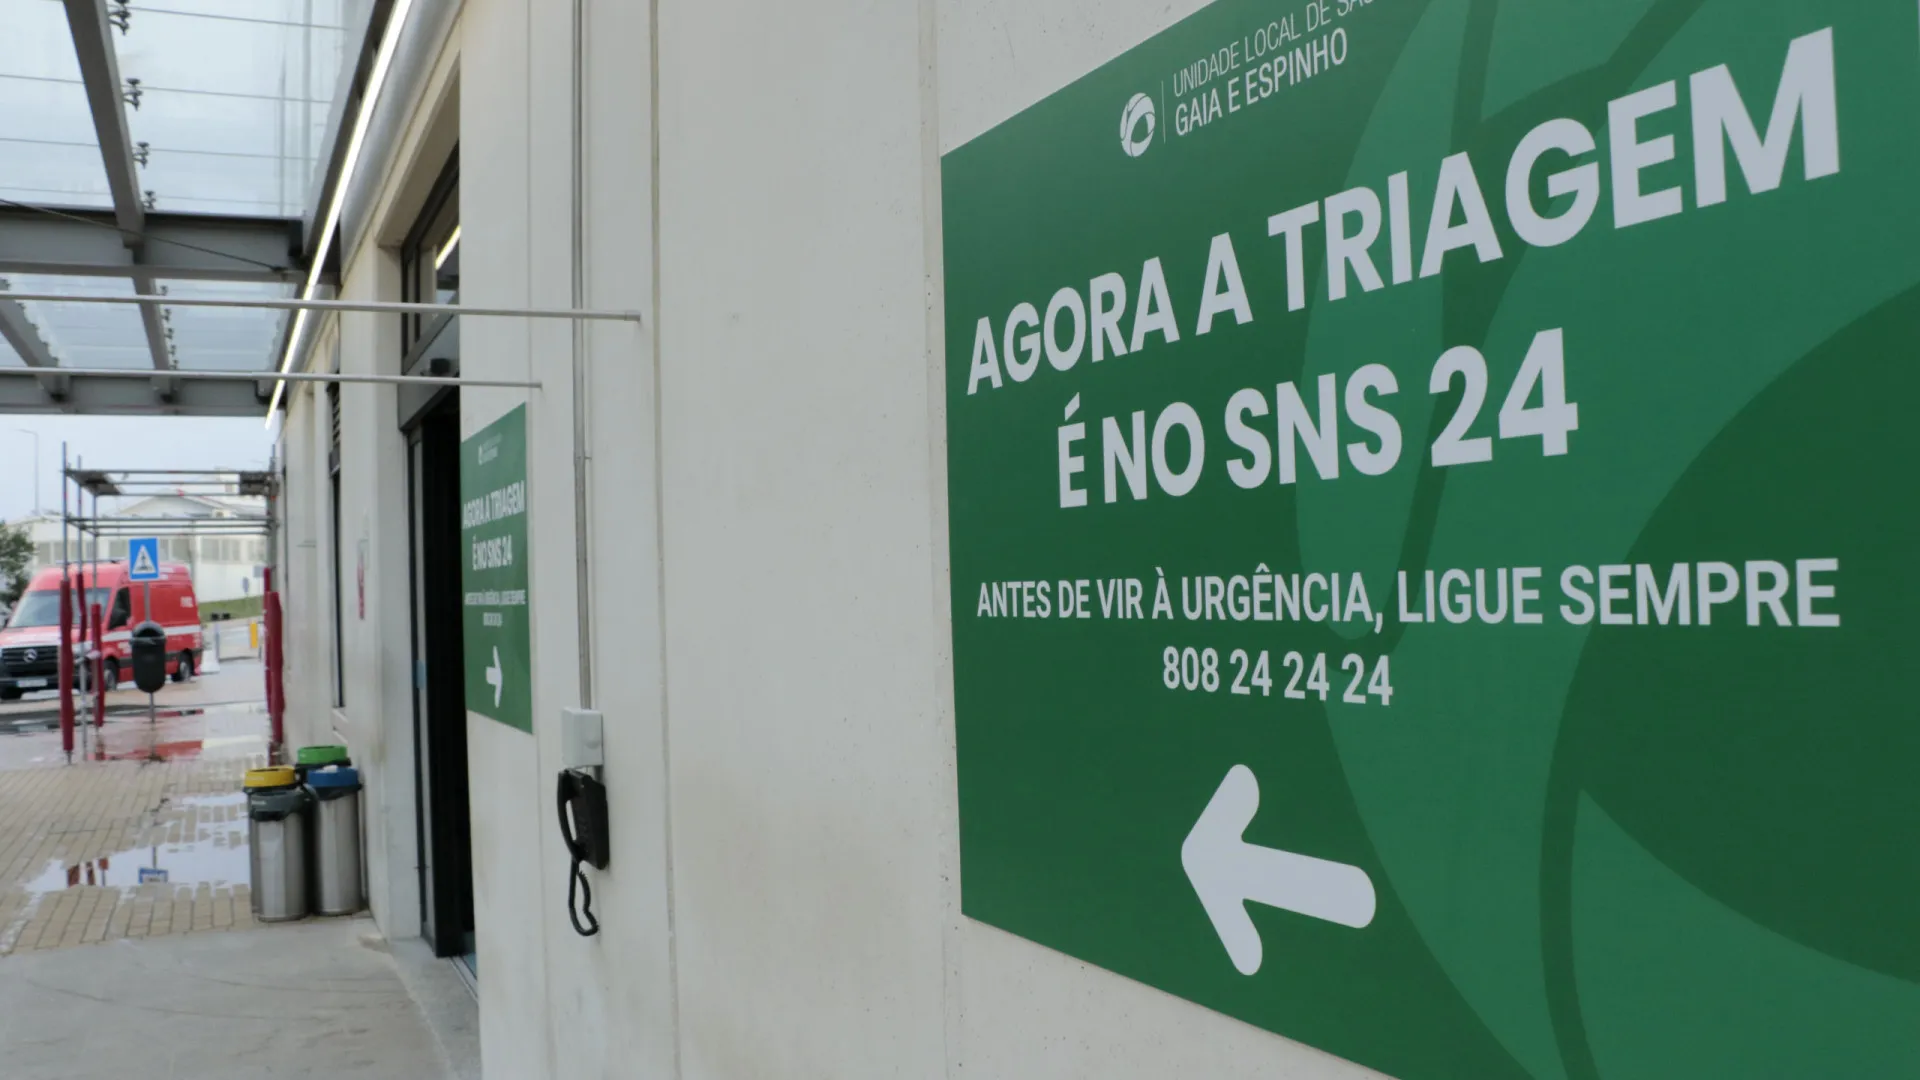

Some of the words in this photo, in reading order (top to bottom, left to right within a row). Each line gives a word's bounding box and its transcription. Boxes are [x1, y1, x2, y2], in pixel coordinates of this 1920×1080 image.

[1173, 41, 1241, 97] UNIDADE
[1244, 13, 1301, 63] LOCAL
[1306, 0, 1332, 32] DE
[1175, 88, 1223, 136] GAIA
[1228, 76, 1241, 113] E
[1246, 27, 1348, 105] ESPINHO
[967, 256, 1180, 395] AGORA
[1195, 232, 1253, 335] A
[1267, 27, 1840, 312] TRIAGEM
[1057, 392, 1088, 508] É
[1102, 401, 1205, 503] NO
[1224, 363, 1402, 489] SNS
[1429, 327, 1579, 467] 24
[977, 580, 1051, 618] ANTES
[1058, 579, 1091, 618] DE
[1096, 578, 1144, 619] VIR
[1151, 566, 1174, 620] À
[1182, 562, 1383, 634] URGÊNCIA,
[1398, 567, 1543, 624] LIGUE
[1560, 558, 1840, 627] SEMPRE
[1163, 646, 1220, 692] 808
[1230, 648, 1273, 696] 24
[1283, 651, 1330, 701] 24
[1341, 653, 1393, 706] 24
